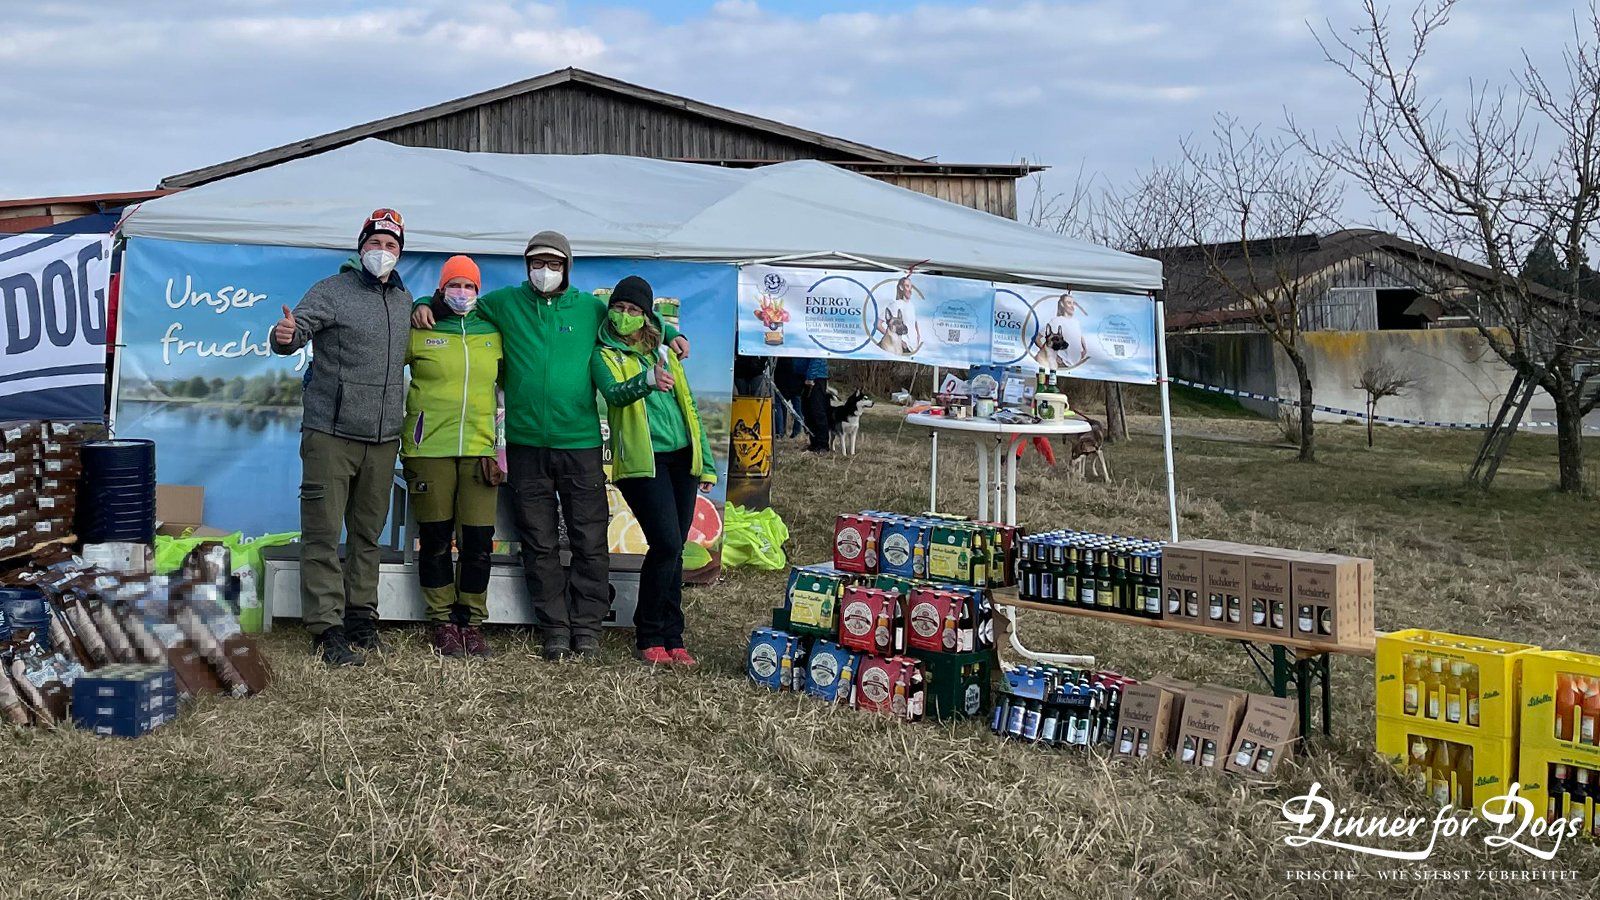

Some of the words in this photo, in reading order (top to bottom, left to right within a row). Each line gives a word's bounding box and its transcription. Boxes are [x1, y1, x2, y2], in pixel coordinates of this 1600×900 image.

[165, 274, 268, 314] Unser
[806, 297, 852, 306] ENERGY
[805, 306, 827, 315] FOR
[830, 307, 862, 316] DOGS
